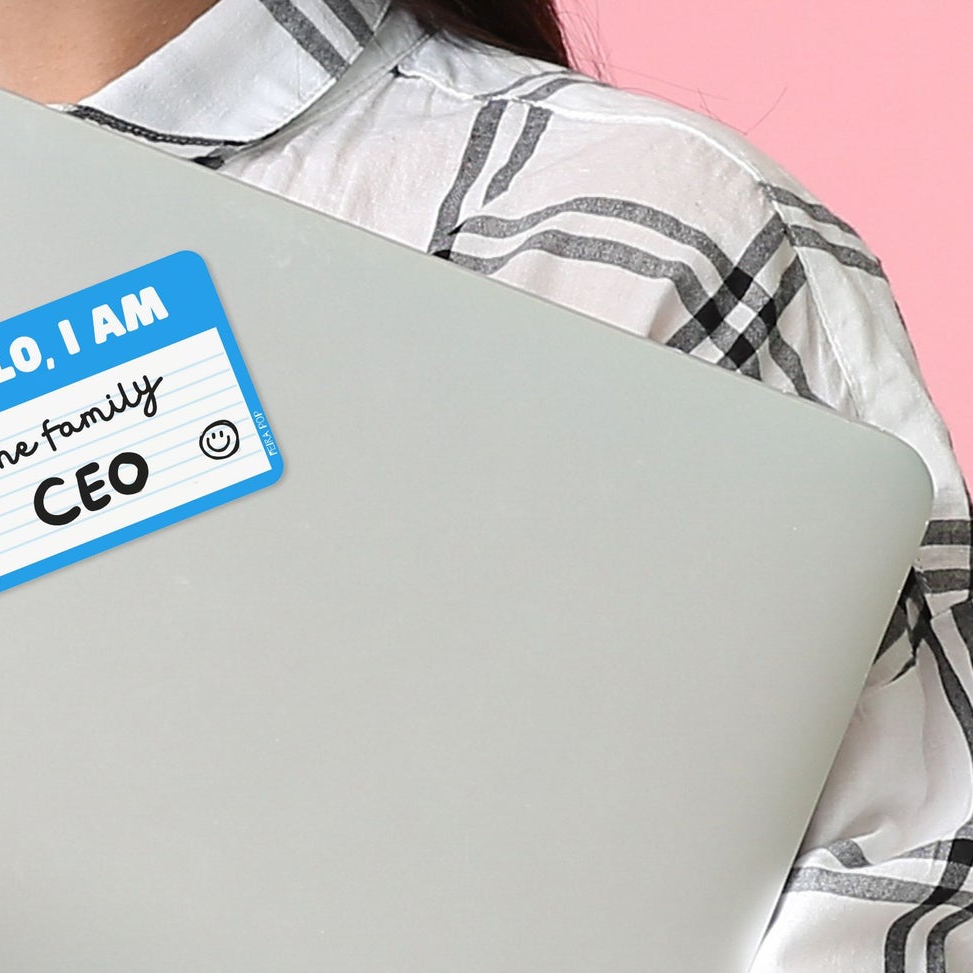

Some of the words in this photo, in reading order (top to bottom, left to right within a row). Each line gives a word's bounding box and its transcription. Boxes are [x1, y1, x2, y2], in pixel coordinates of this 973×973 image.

[58, 319, 81, 355] I
[91, 286, 169, 345] AM
[41, 374, 163, 452] family
[253, 411, 267, 430] POP
[263, 430, 278, 456] FEIRA
[33, 451, 150, 526] CEO
